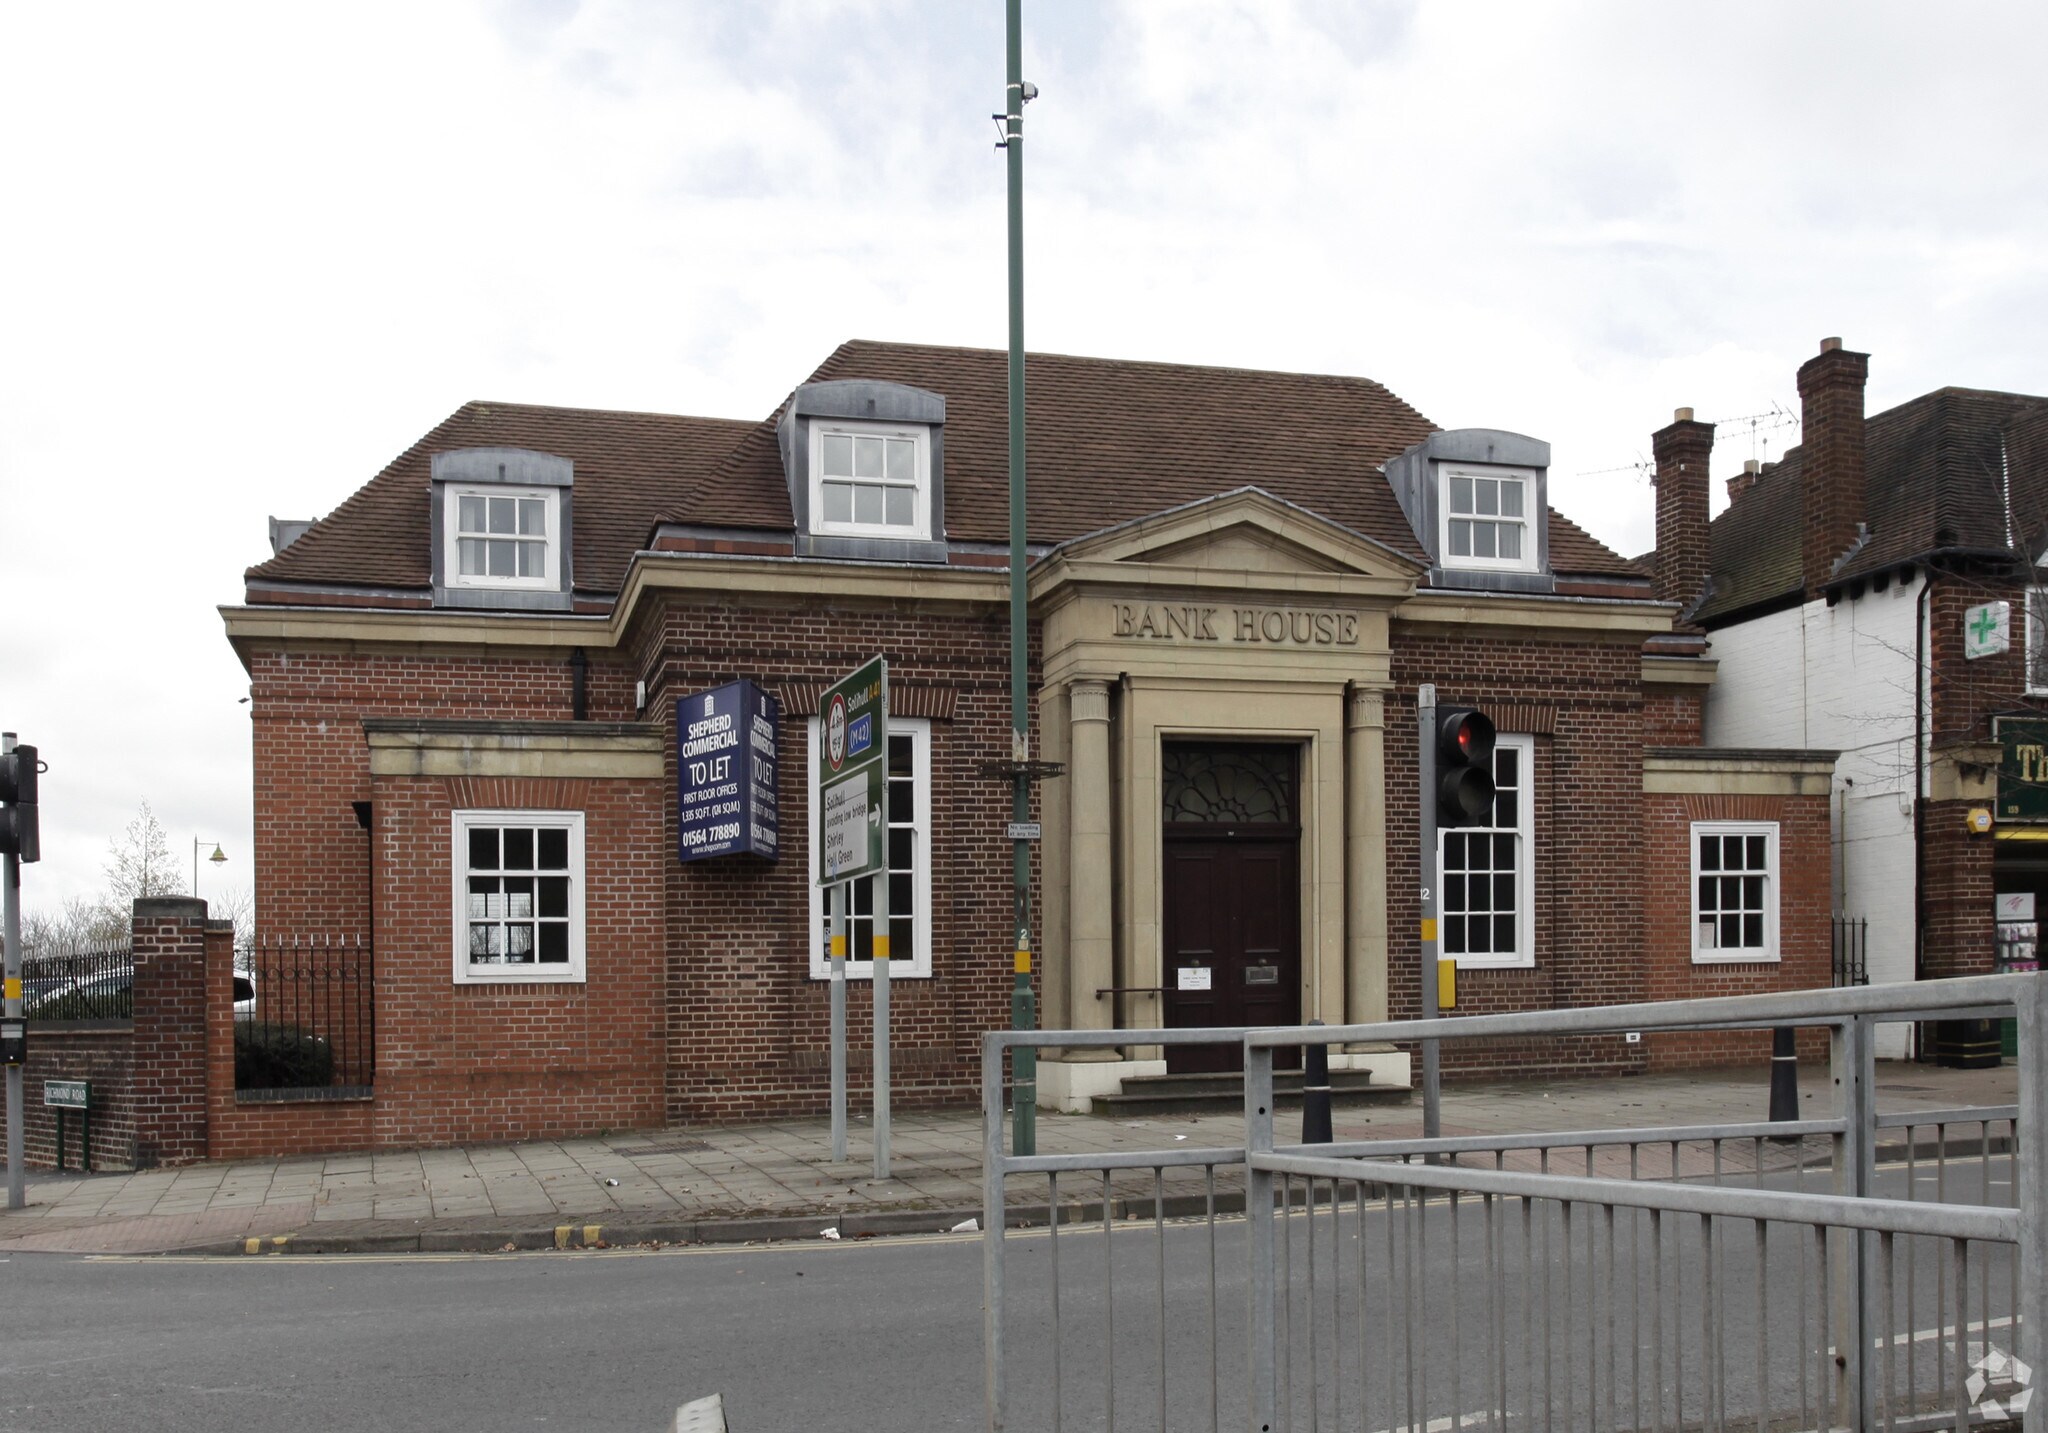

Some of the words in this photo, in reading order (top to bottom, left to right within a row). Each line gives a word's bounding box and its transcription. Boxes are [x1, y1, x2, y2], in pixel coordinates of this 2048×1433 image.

[1113, 604, 1218, 641] BANK
[1233, 609, 1359, 646] HOUSE
[848, 687, 869, 713] Solihull
[688, 714, 731, 740] SHEPHERD
[682, 730, 739, 758] COMMERCIAL
[689, 761, 706, 786] TO
[710, 755, 731, 782] LET
[753, 755, 762, 781] TO
[763, 762, 773, 786] LET
[683, 791, 697, 804] FIRST
[698, 787, 716, 801] FLOOR
[716, 782, 738, 798] OFFICES
[827, 790, 845, 812] Solihull
[827, 811, 843, 828] avoiding
[852, 802, 866, 818] bridge
[682, 828, 707, 847] 01564
[709, 822, 740, 842] 778890
[827, 831, 843, 849] Shirley
[827, 851, 837, 868] Hall
[838, 850, 853, 865] Green
[46, 1086, 70, 1100] RICHMOND
[72, 1088, 87, 1101] ROAD
